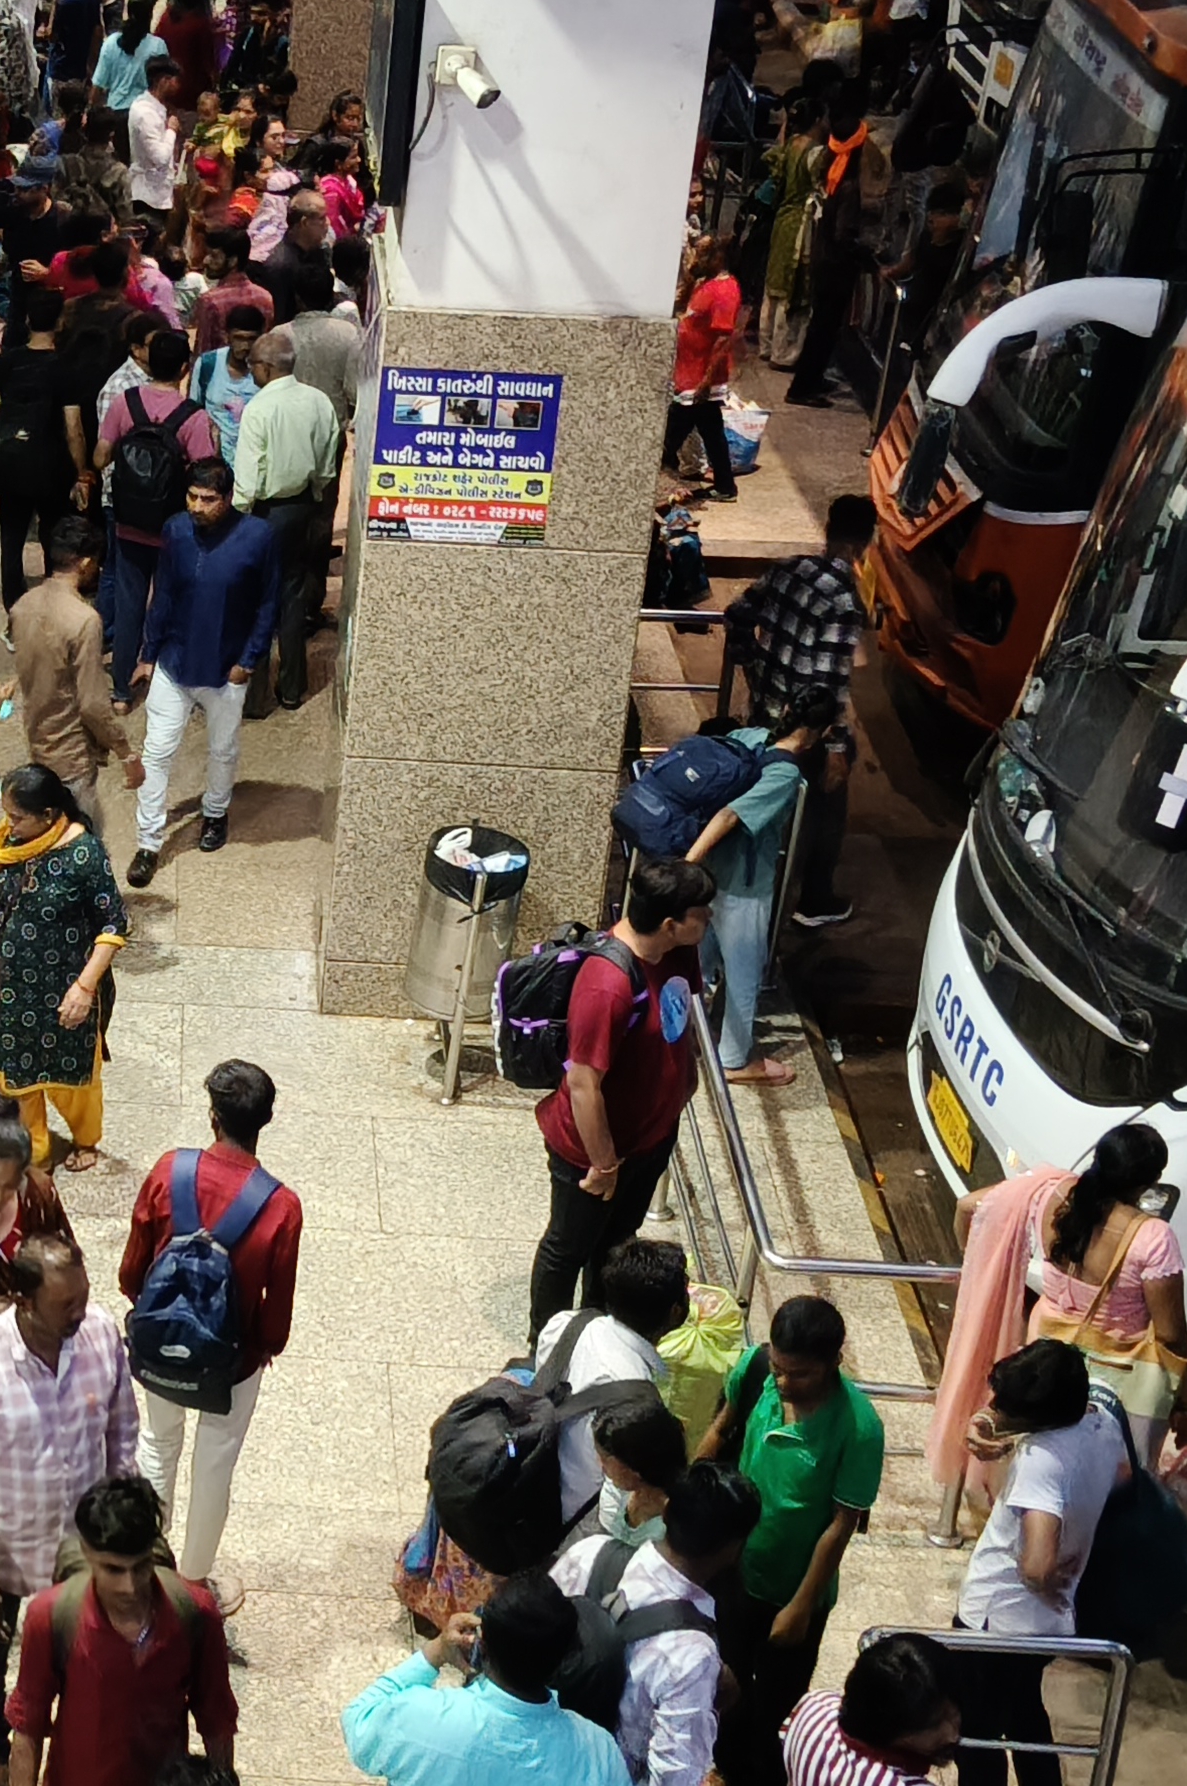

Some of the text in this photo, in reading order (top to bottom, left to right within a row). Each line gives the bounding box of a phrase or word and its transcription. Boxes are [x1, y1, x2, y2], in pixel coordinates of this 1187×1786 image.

[387, 369, 554, 398] ખિસ્સા કાતરુંથી સાવધાન
[415, 428, 516, 448] તમારા મોબાઈલ
[381, 446, 545, 470] પાકીટ અને બેગને સાચવો
[413, 471, 509, 486] રાજકોટ શહેર પોલીસ
[456, 486, 488, 498] પોલીસ
[492, 487, 522, 500] સ્ટેશન
[377, 499, 399, 516] ફોન
[402, 499, 430, 517] નંબર
[935, 973, 1005, 1107] GSRTC
